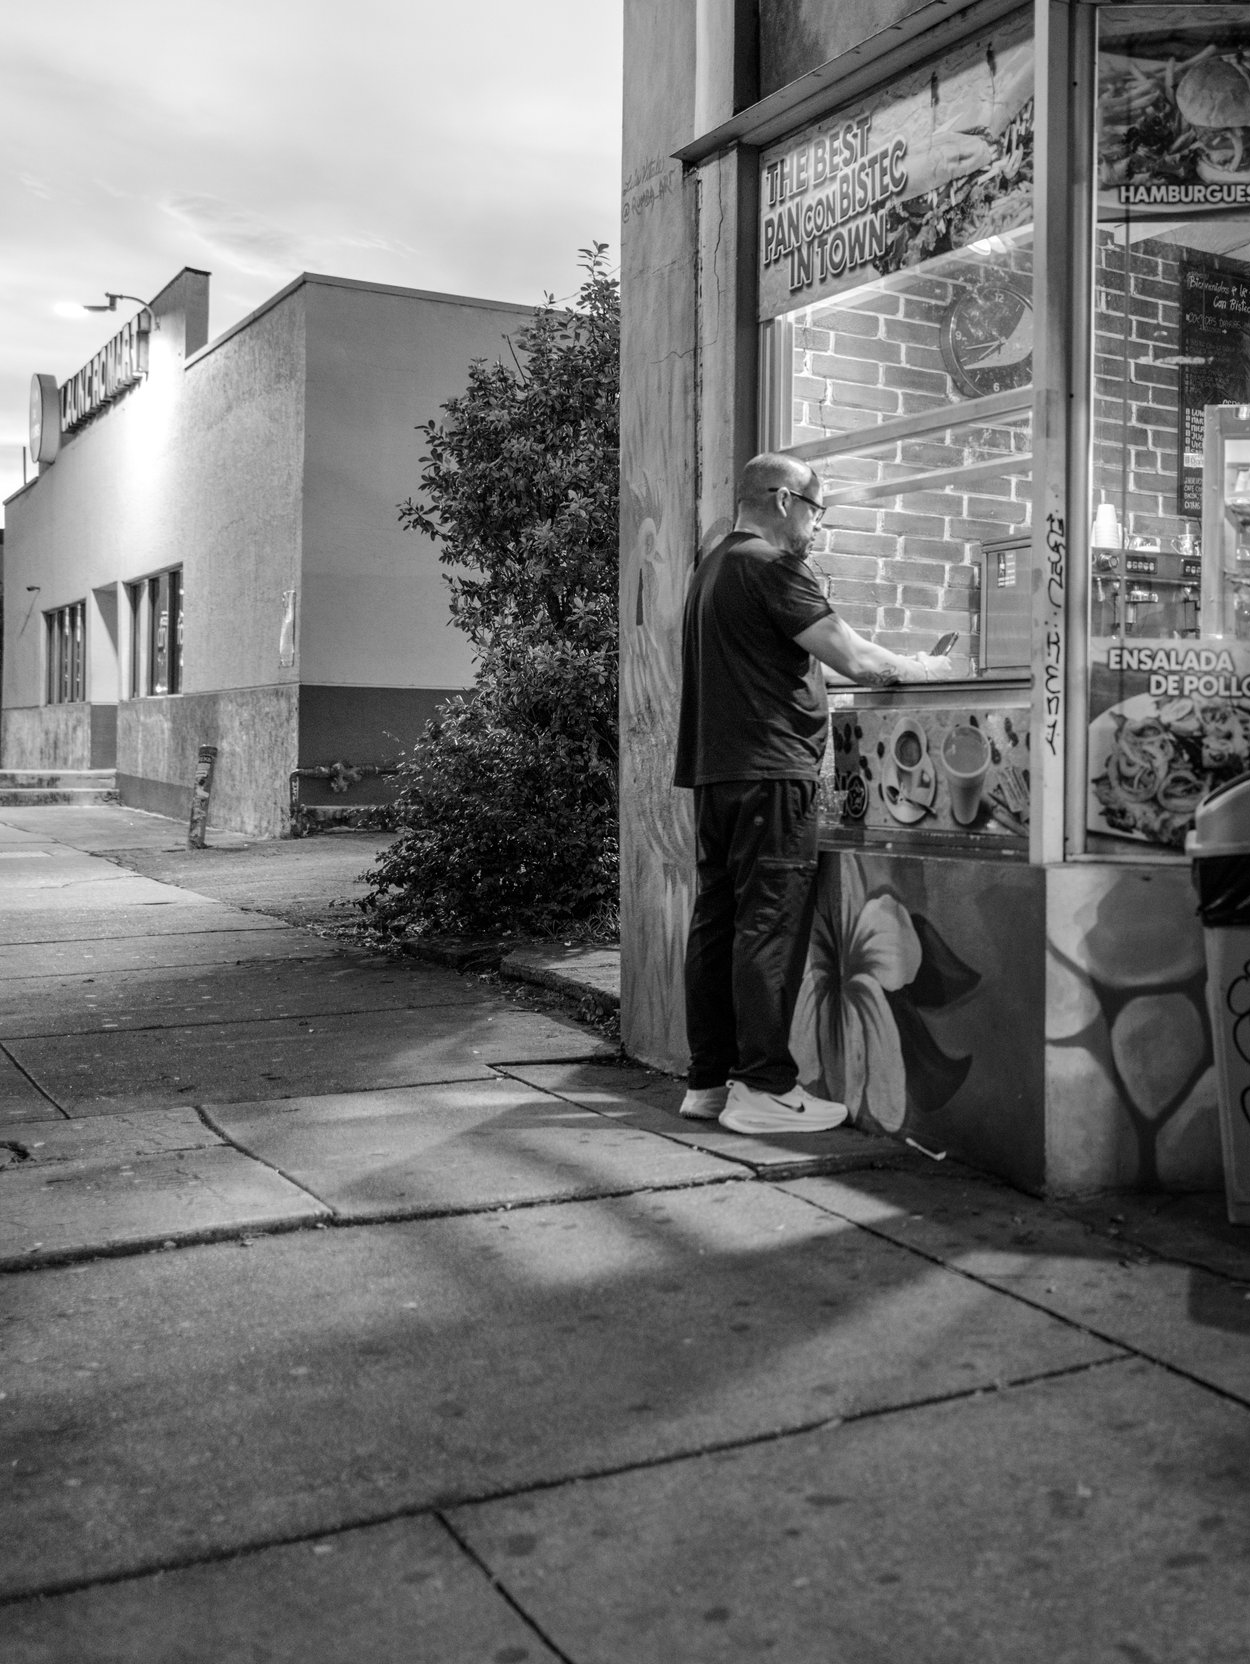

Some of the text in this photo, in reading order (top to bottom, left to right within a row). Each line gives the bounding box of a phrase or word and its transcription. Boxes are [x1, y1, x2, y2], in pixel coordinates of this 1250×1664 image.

[766, 114, 872, 206] THE BEST
[763, 138, 907, 267] PAN CON BISTEC
[788, 209, 889, 292] IN TOWN
[1108, 647, 1234, 673] ENSALADA
[1149, 673, 1181, 697] DE
